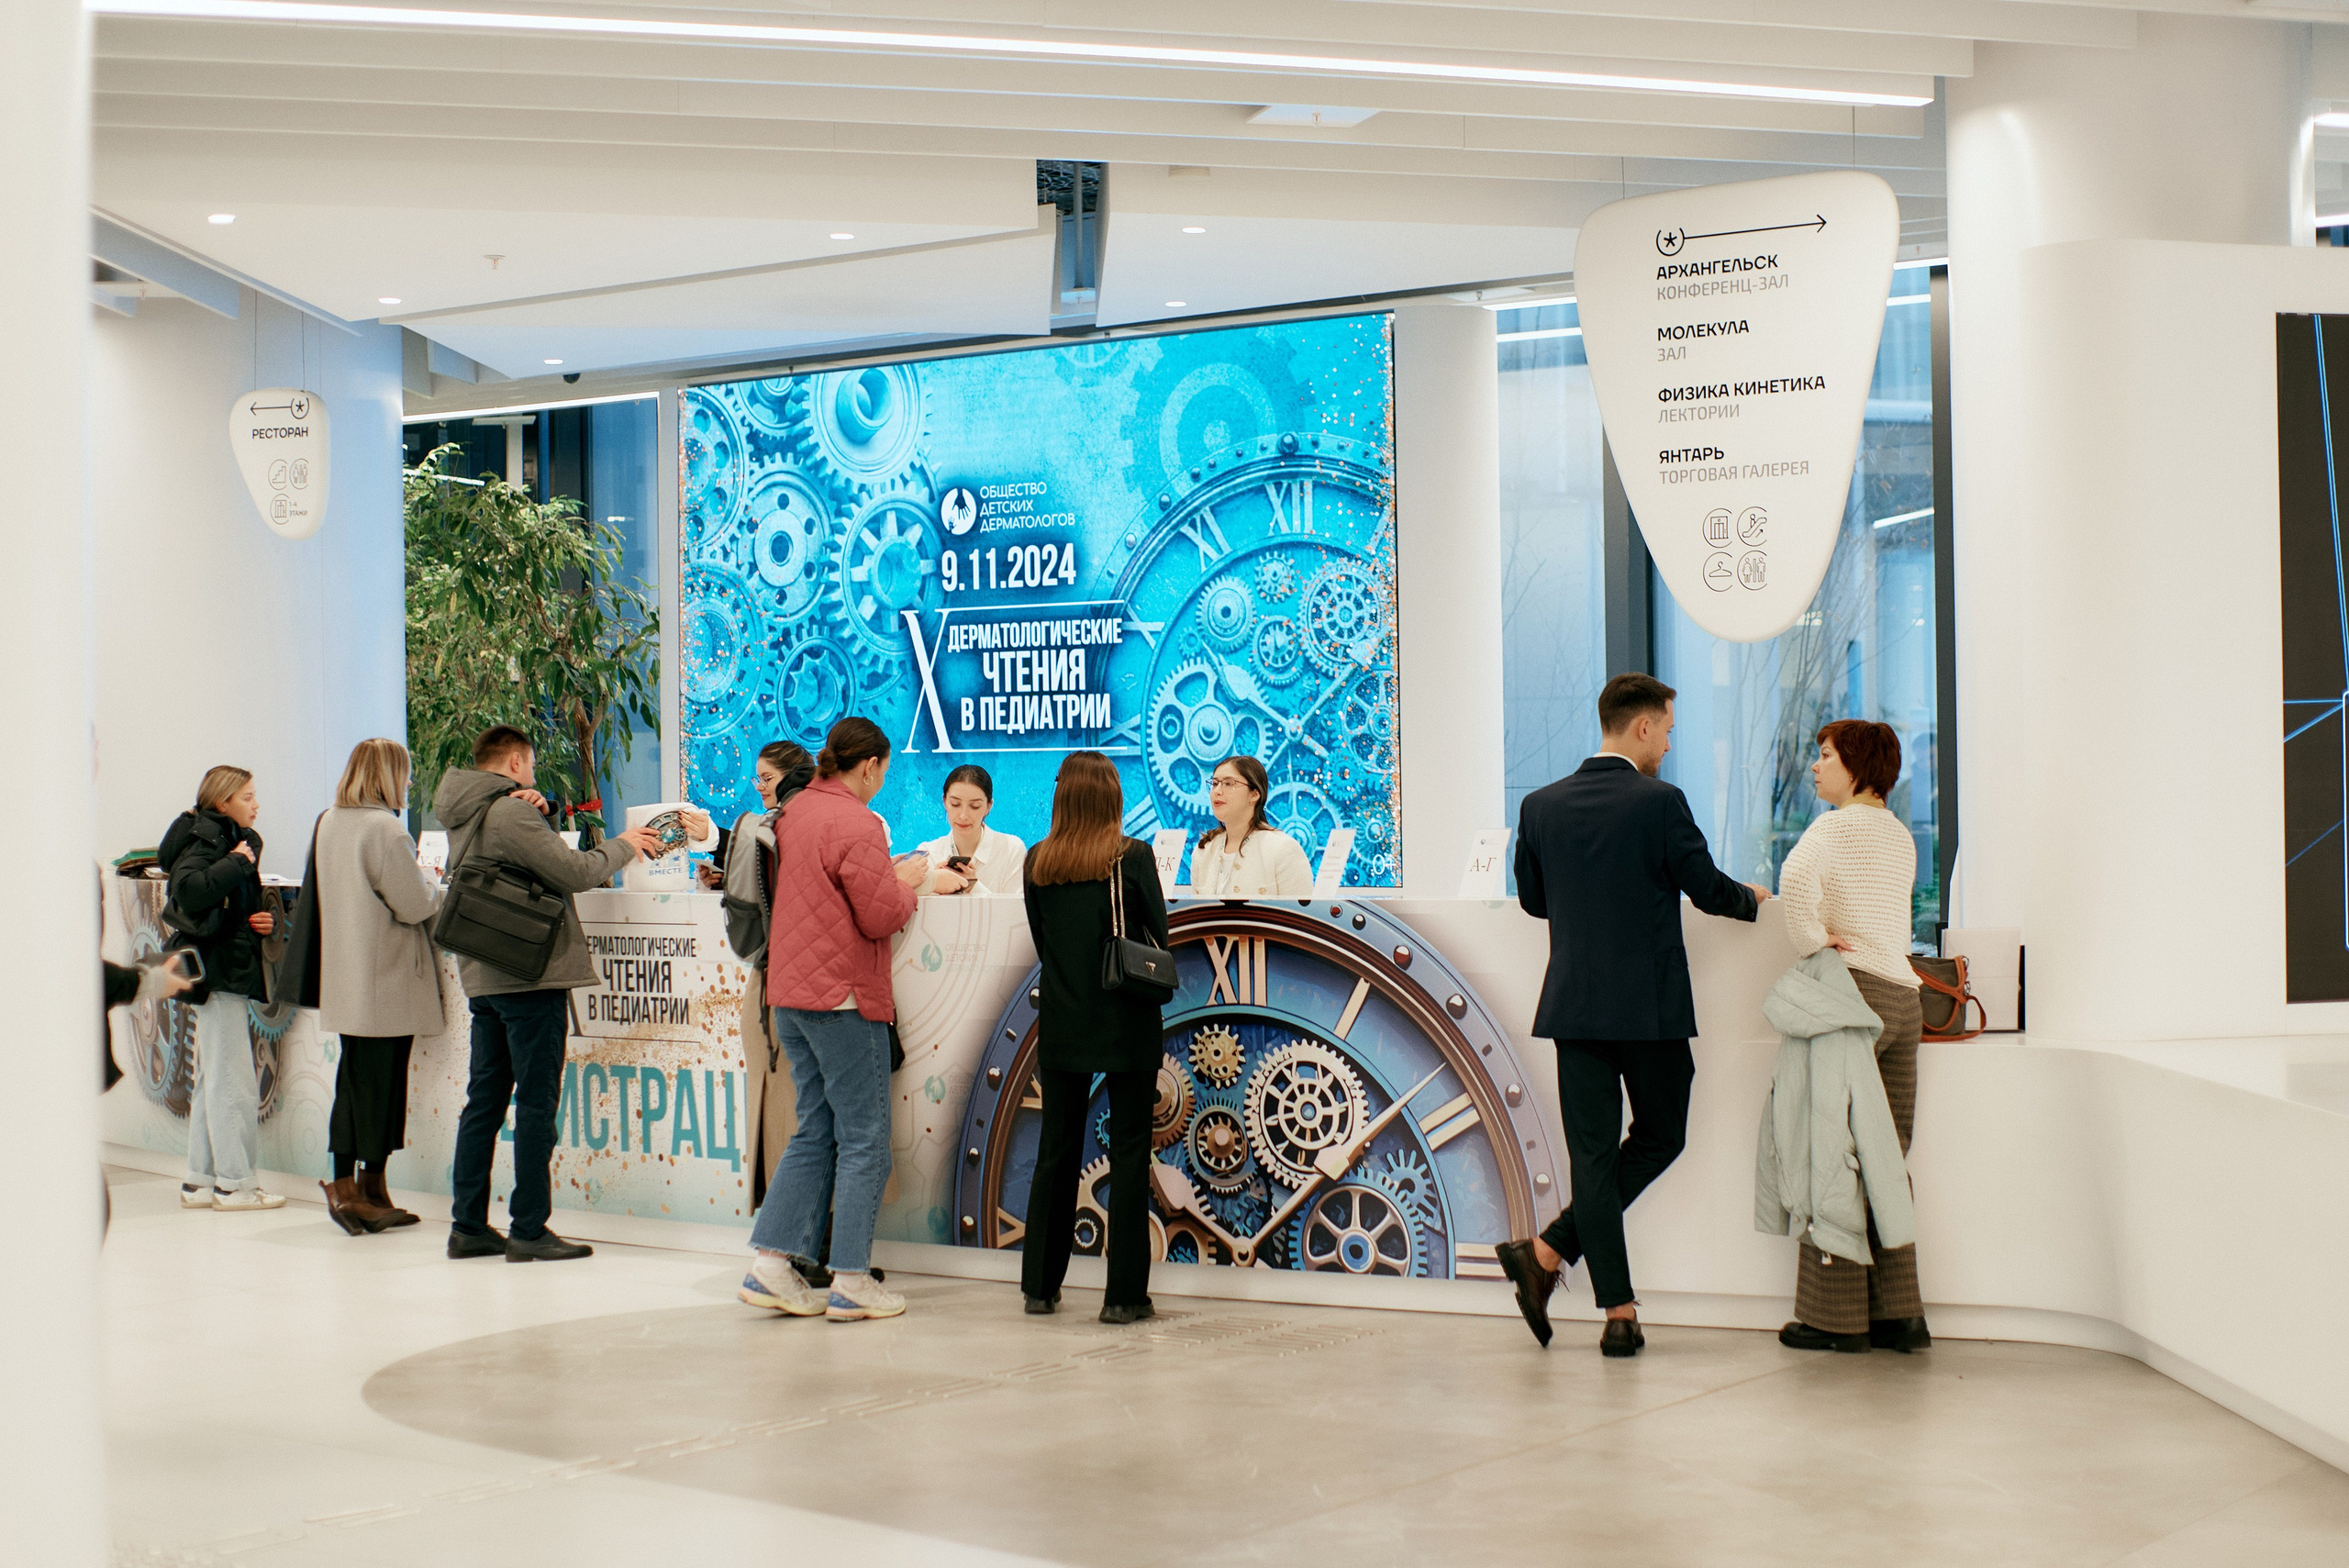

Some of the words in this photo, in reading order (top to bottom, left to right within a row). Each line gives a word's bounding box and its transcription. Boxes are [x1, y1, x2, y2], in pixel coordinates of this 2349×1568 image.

[1656, 254, 1778, 280] АРХАНГЕЛЬСК
[1657, 273, 1789, 301] КОНФЕРЕНЦ-ЗАЛ
[1657, 319, 1750, 341] МОЛЕКУЛА
[1657, 346, 1687, 361] ЗАЛ
[1658, 384, 1730, 403] ФИЗИКА
[1734, 375, 1826, 395] КИНЕТИКА
[1658, 404, 1740, 423] ЛЕКТОРИИ
[251, 427, 308, 439] РЕСТОРАН
[1659, 447, 1725, 463] ЯНТАРЬ
[1659, 466, 1738, 484] ТОРГОВАЯ
[1742, 461, 1809, 479] ГАЛЕРЕЯ
[979, 482, 1047, 499] ОБЩЕСТВО
[979, 499, 1034, 517] ДЕТСКИХ
[979, 513, 1075, 533] ДЕРМАТОЛОГОВ
[941, 543, 1076, 592] 9.11.2024
[947, 617, 1123, 653] ДЕРМАТОЛОГИЧЕСКИЕ
[983, 649, 1086, 693] ЧТЕНИЯ
[961, 697, 975, 731] В
[980, 693, 1111, 735] ПЕДИАТРИИ
[649, 866, 683, 876] ВМЕСТЕ
[1373, 853, 1397, 875] 0+
[1469, 857, 1497, 873] А-Г
[586, 935, 697, 958] ЕРМАТОЛОГИЧЕСКИЕ
[602, 959, 673, 994] ЧТЕНИЯ
[588, 994, 597, 1020] В
[601, 995, 690, 1026] ПЕДИАТРИИ
[500, 1062, 748, 1173] ИСТРАЦ
